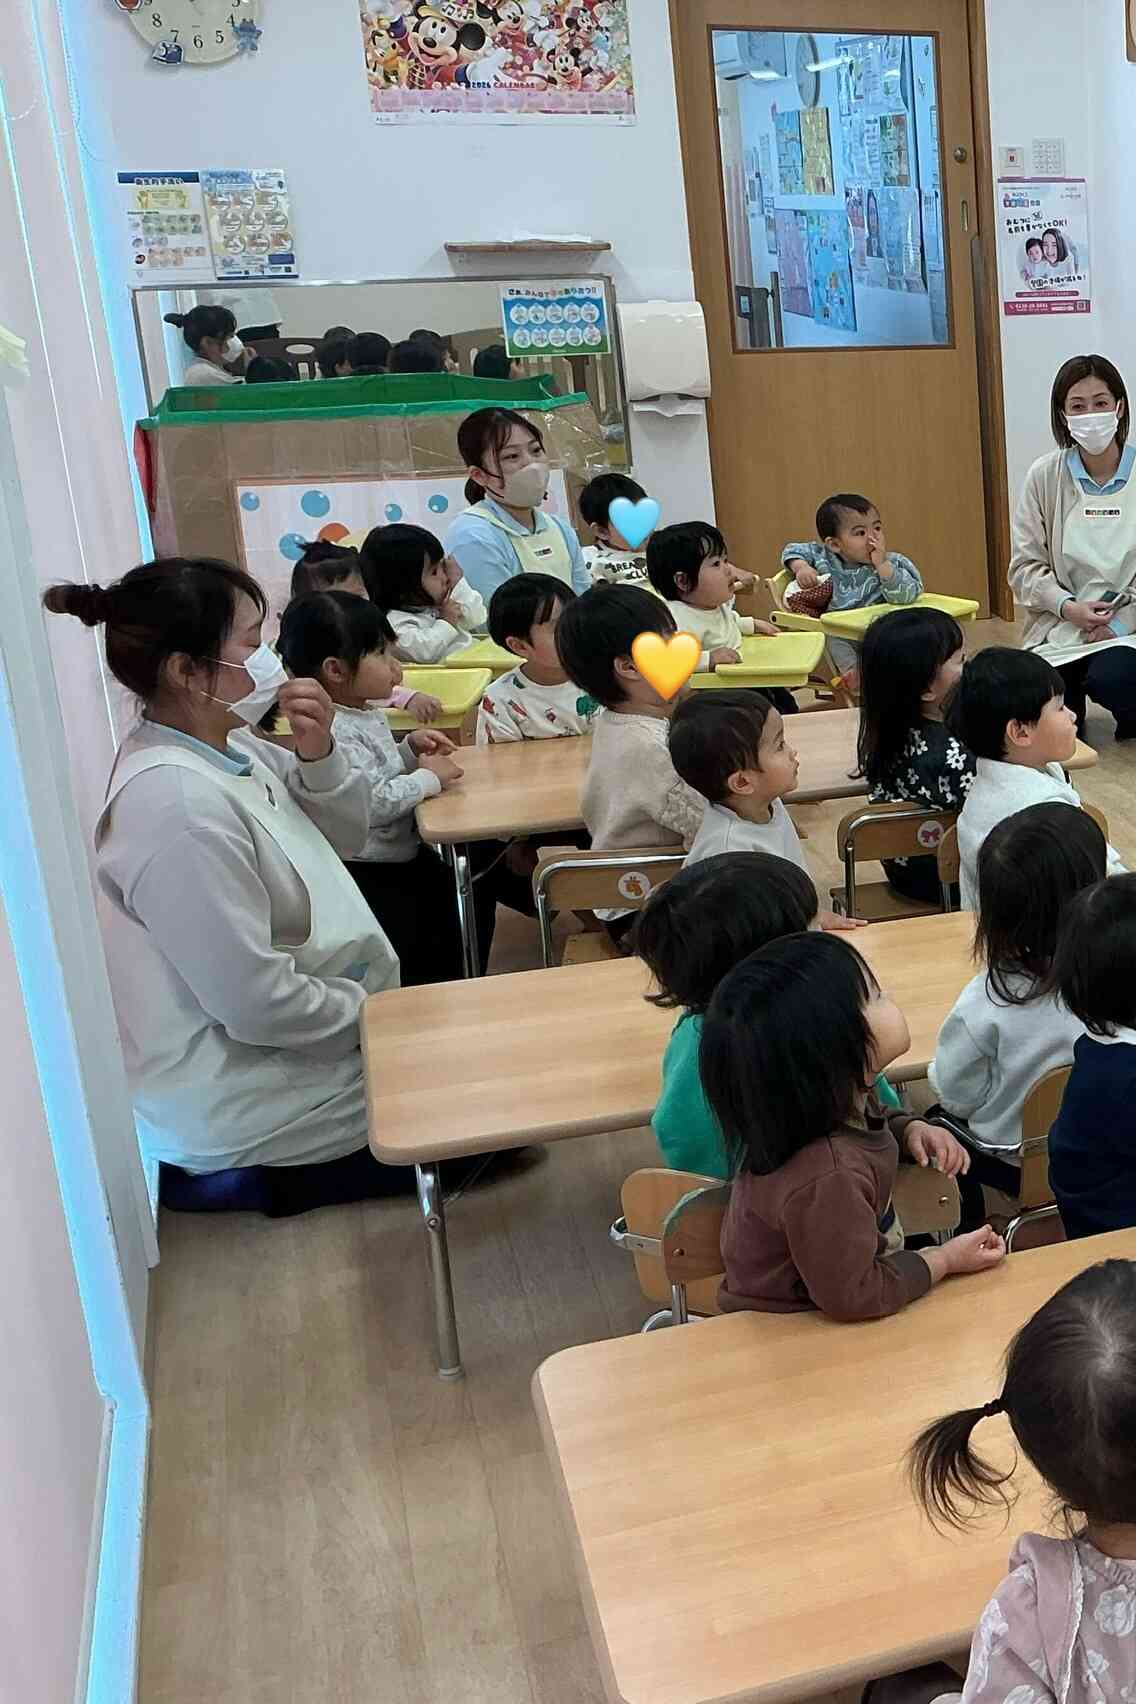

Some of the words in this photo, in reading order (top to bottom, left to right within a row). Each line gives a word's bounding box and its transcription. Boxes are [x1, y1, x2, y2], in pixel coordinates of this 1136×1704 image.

[152, 13, 162, 27] 8
[226, 14, 235, 27] 4
[170, 30, 179, 42] 7
[193, 35, 203, 48] 6
[215, 30, 224, 43] 5
[493, 81, 536, 89] CALENDAR
